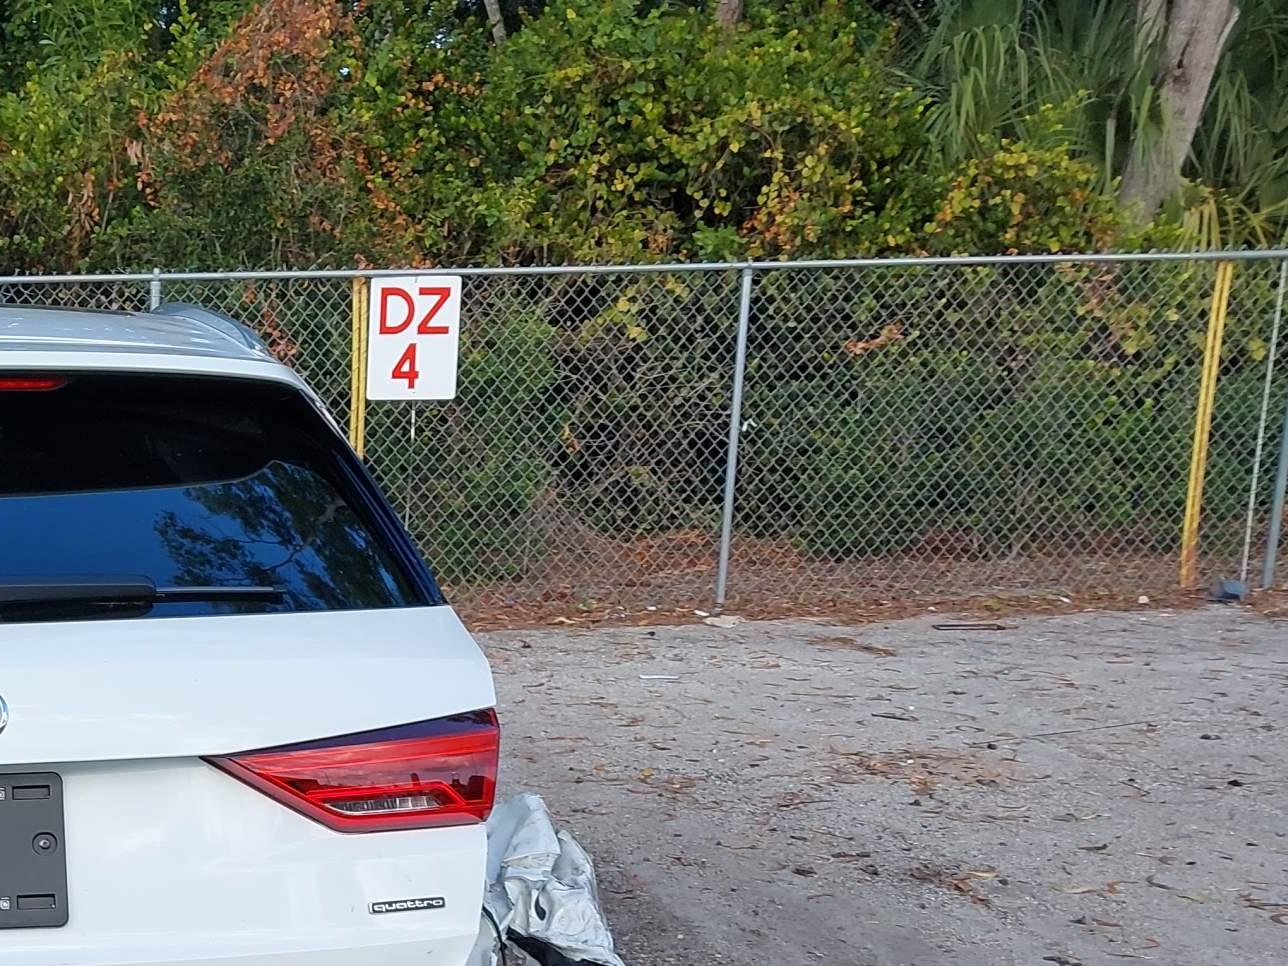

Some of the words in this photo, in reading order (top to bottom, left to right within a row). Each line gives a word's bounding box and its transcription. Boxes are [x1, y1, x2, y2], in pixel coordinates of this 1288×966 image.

[379, 287, 452, 335] DZ
[391, 342, 419, 389] 4
[373, 898, 444, 912] quattro
